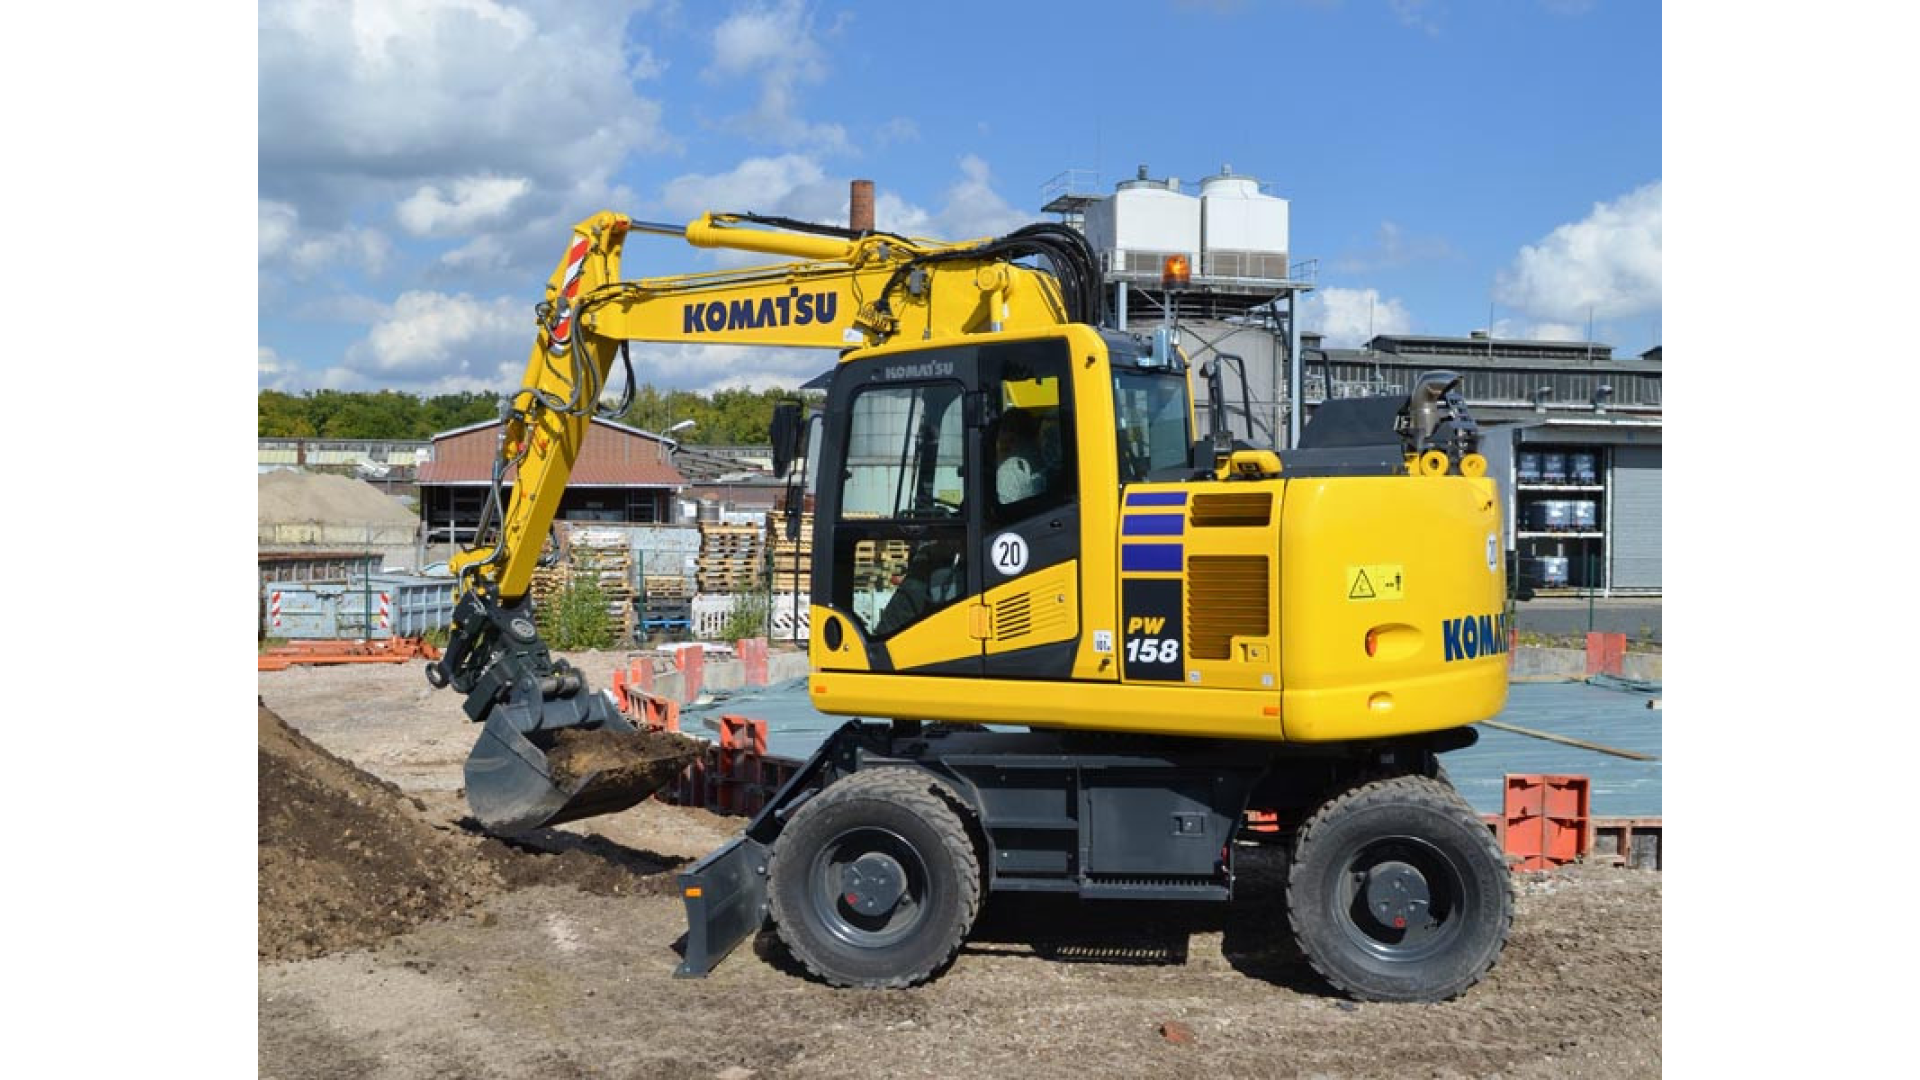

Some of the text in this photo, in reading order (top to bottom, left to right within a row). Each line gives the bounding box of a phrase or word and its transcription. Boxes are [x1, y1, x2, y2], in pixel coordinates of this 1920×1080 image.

[683, 286, 837, 333] KOMATSU
[886, 360, 954, 379] KOMATSU
[999, 541, 1020, 567] 20
[1127, 617, 1165, 635] PW
[1126, 638, 1179, 663] 158
